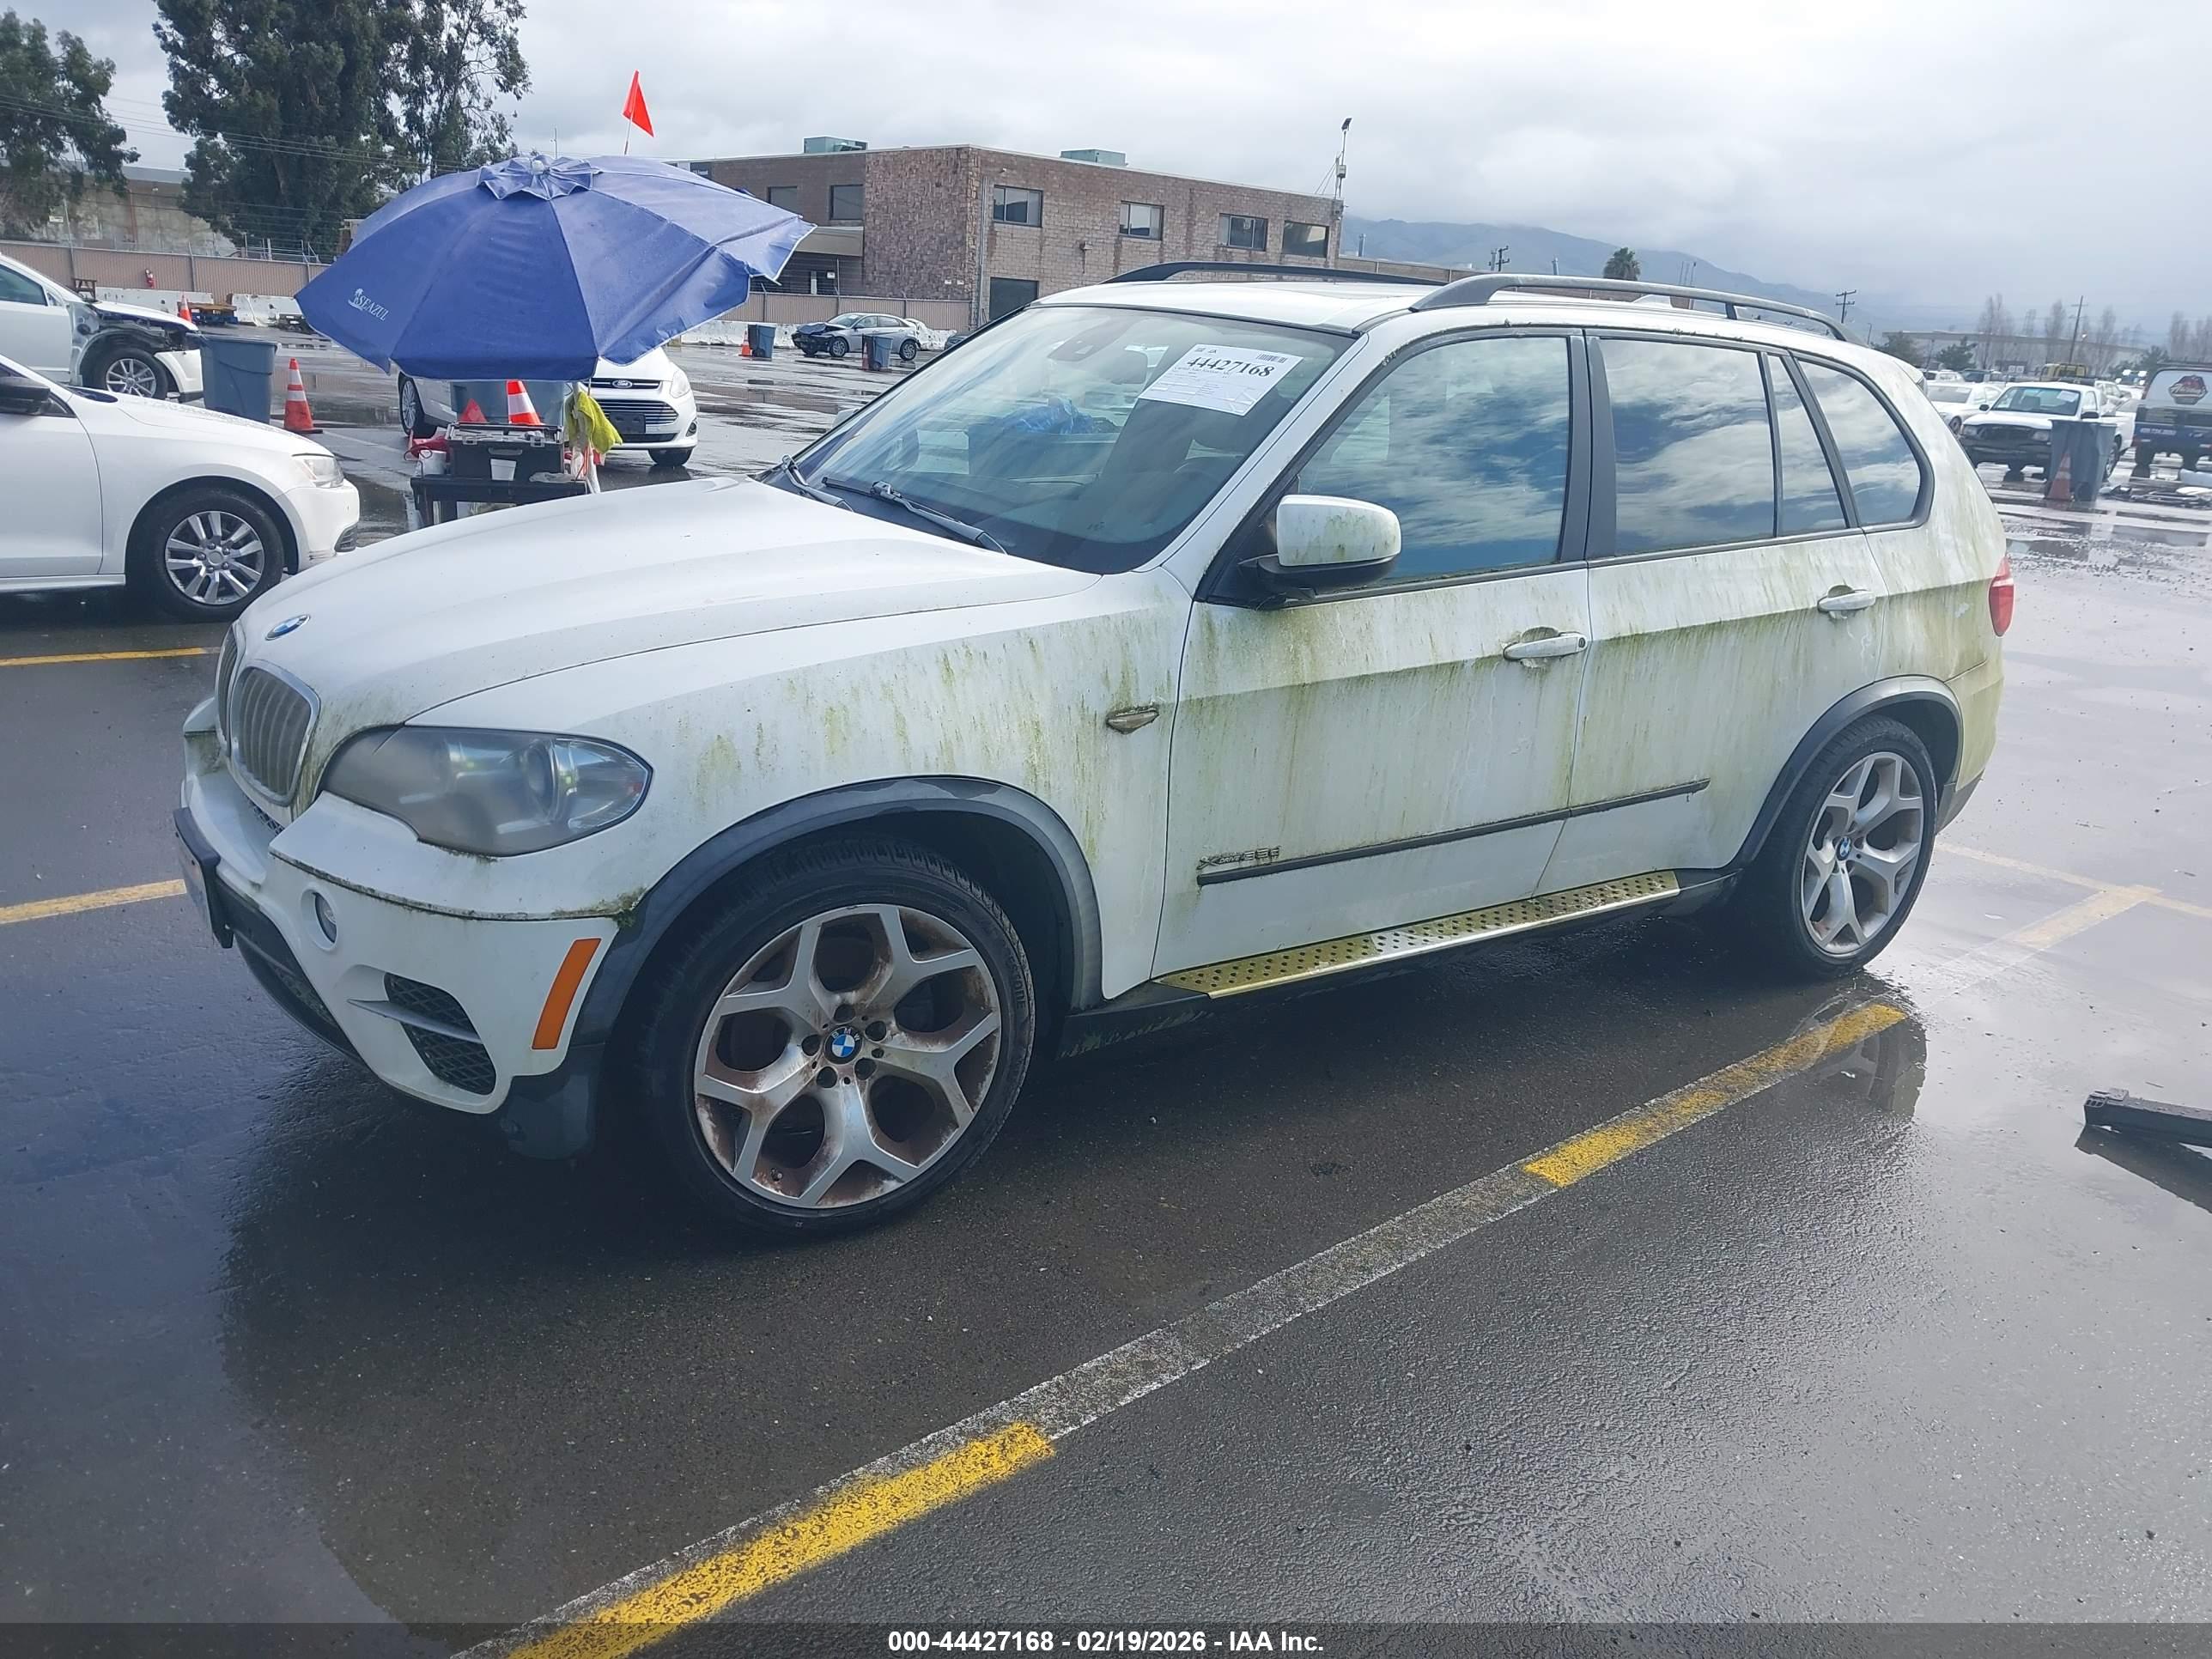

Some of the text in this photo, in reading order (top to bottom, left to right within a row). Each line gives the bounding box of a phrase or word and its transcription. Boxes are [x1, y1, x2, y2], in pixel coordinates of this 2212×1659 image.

[356, 295, 389, 321] SEAZUL
[1187, 356, 1275, 378] 44427168
[831, 1026, 860, 1042] BMW
